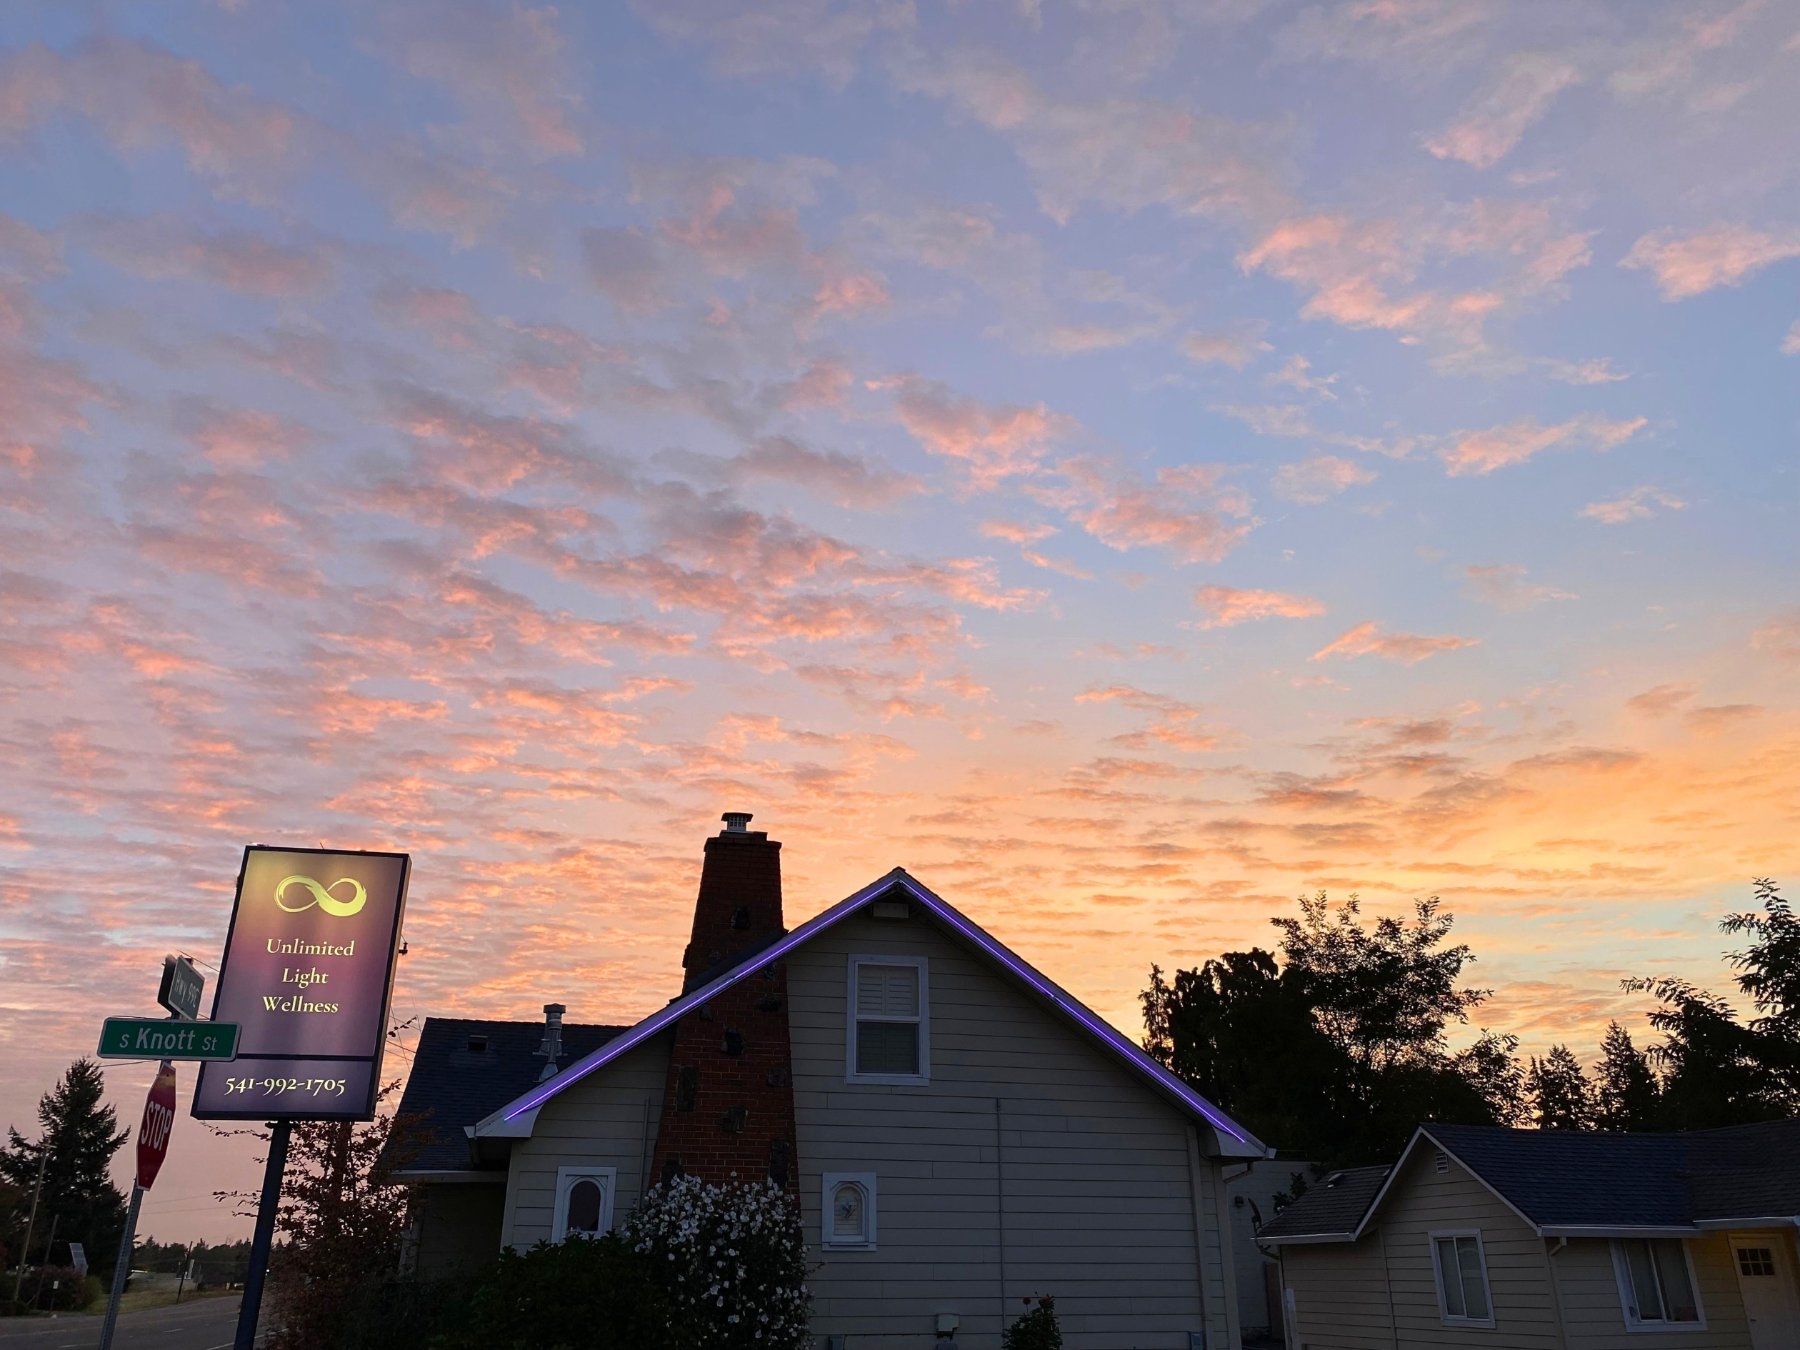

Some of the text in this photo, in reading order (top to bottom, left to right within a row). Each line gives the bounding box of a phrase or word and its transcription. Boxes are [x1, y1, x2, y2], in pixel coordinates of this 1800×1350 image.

[267, 938, 355, 956] Unlimited
[282, 967, 329, 988] Light
[263, 996, 339, 1013] Wellness
[136, 1028, 195, 1050] Knott
[202, 1036, 217, 1051] St
[224, 1077, 346, 1097] 541-992-1705
[141, 1101, 172, 1151] STOP
